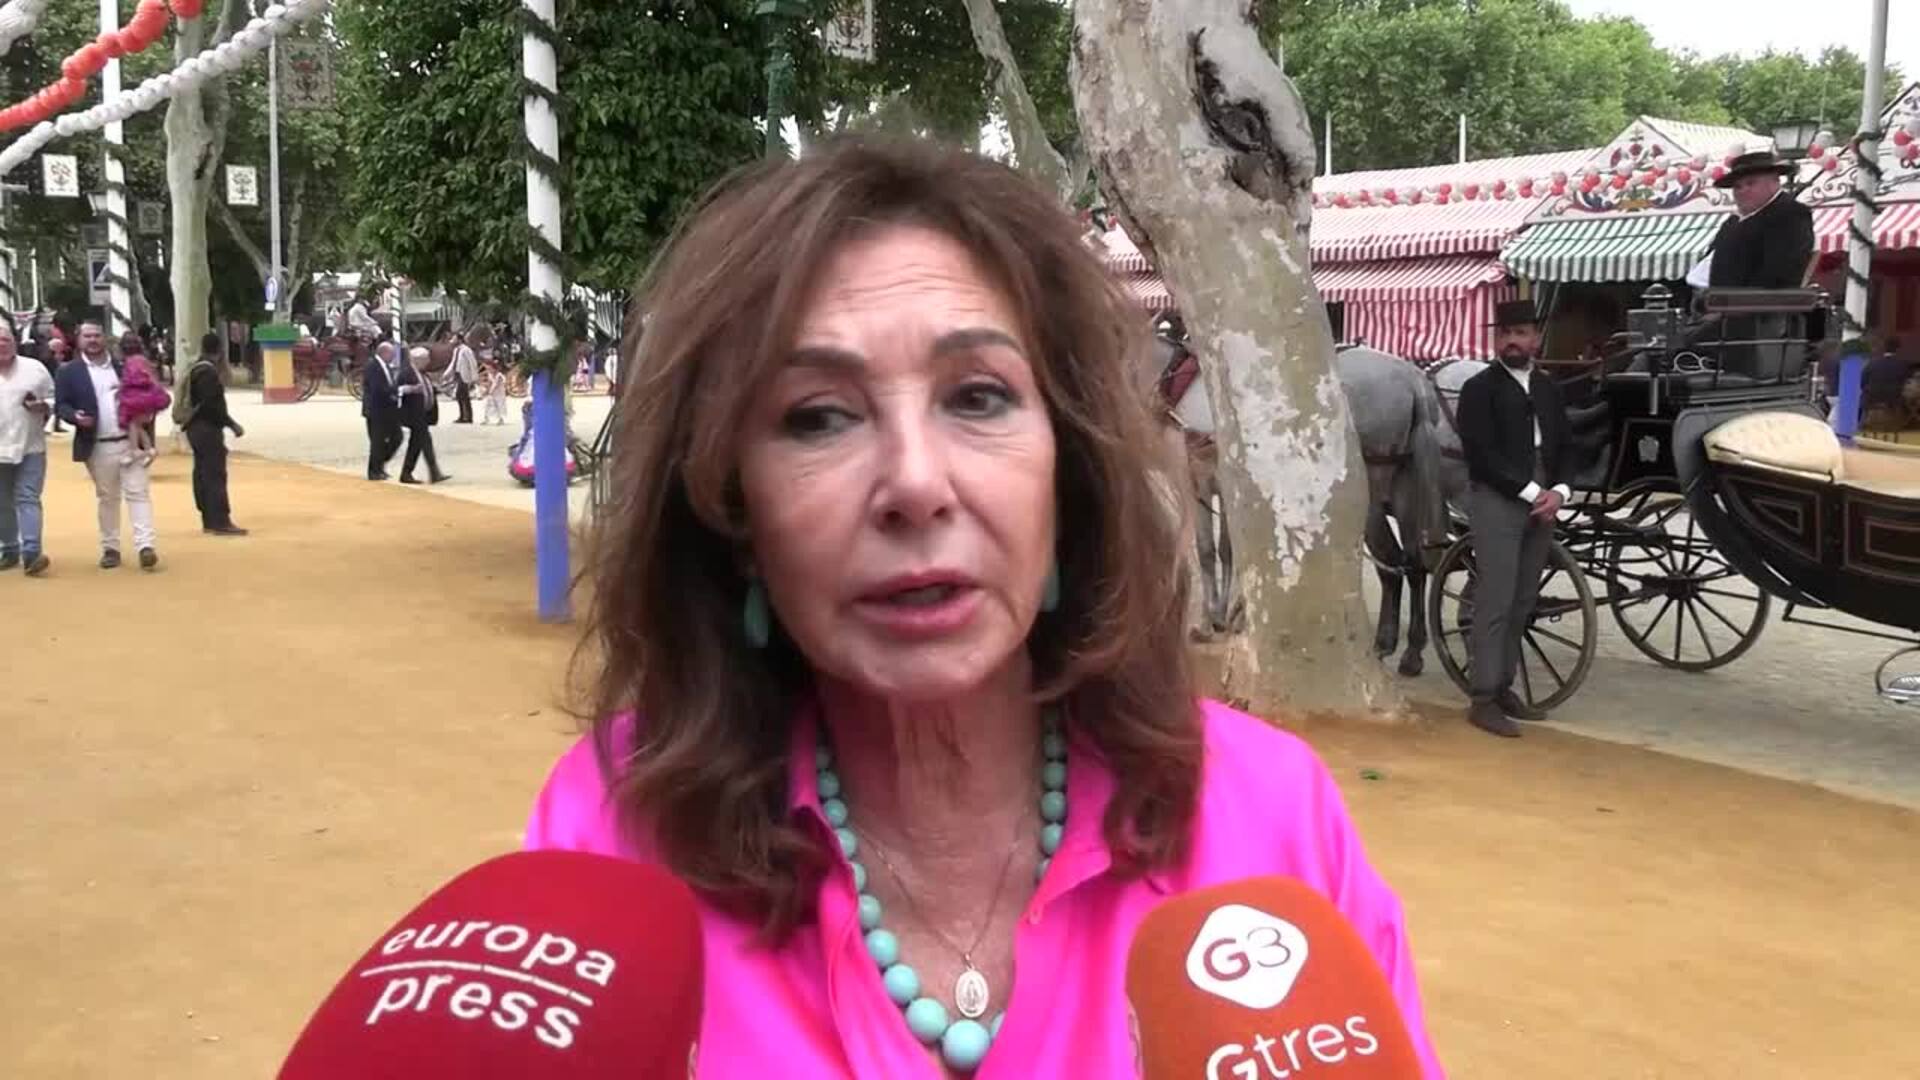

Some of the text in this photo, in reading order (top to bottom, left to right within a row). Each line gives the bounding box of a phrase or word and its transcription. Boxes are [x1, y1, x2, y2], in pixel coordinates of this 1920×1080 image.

[382, 921, 616, 986] europa
[1203, 926, 1291, 982] G3
[365, 974, 581, 1049] press
[1206, 1016, 1379, 1080] Gtres
